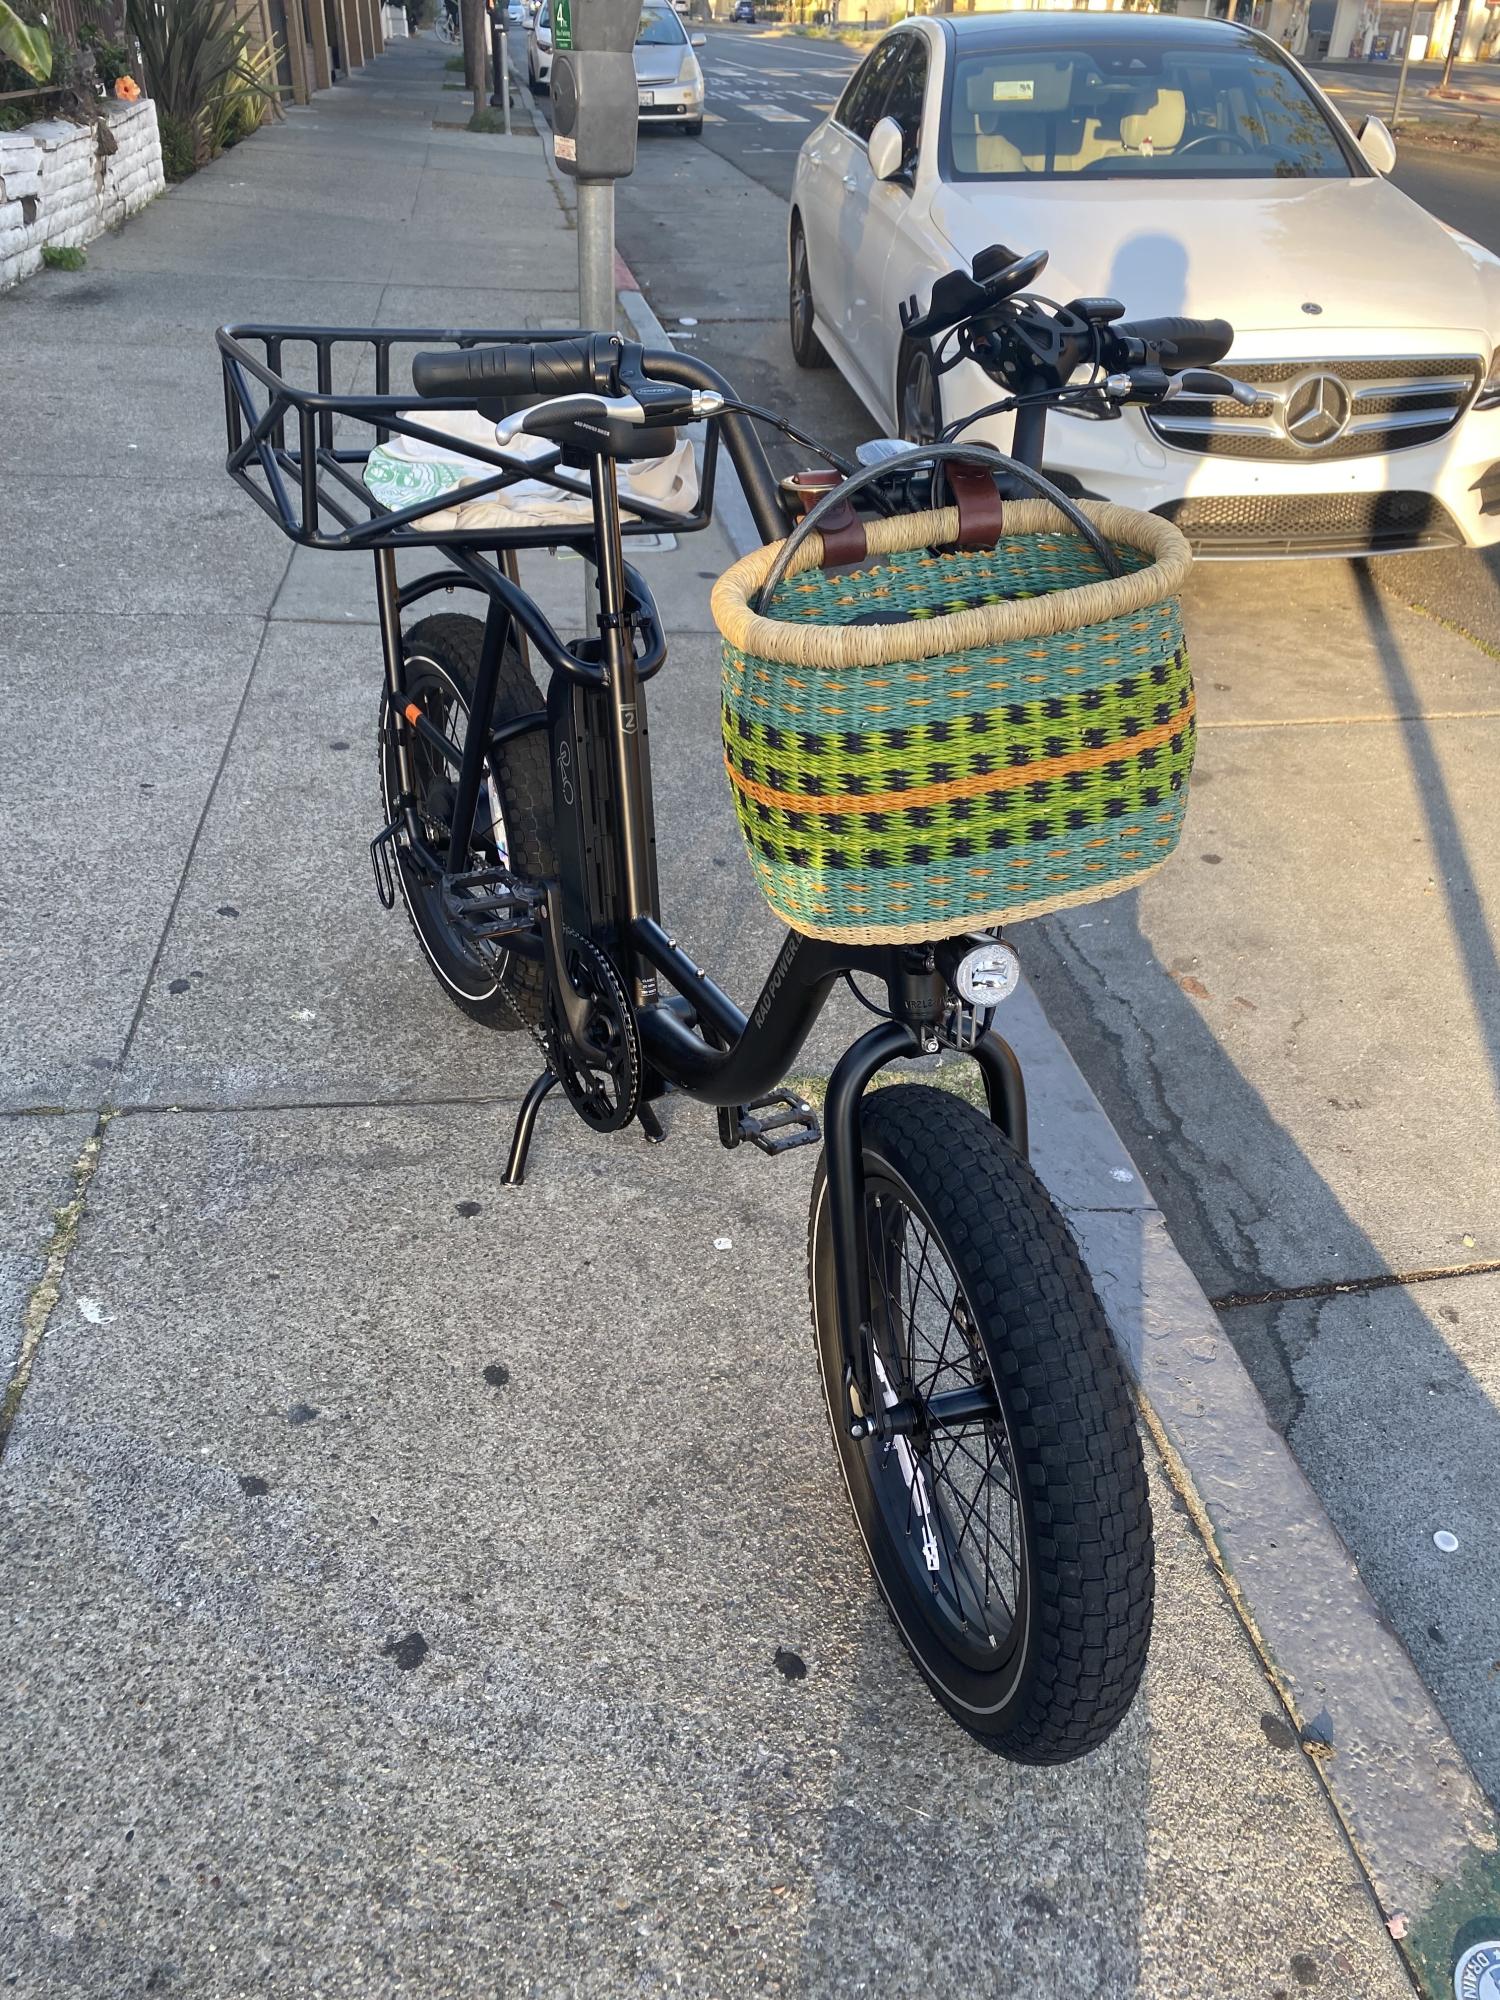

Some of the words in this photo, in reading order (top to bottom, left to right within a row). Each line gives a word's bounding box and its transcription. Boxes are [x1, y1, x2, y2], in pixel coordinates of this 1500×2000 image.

[624, 712, 635, 728] 2
[754, 993, 771, 1029] RAD
[769, 938, 799, 998] POWER
[1463, 1952, 1490, 1998] DRAIN
